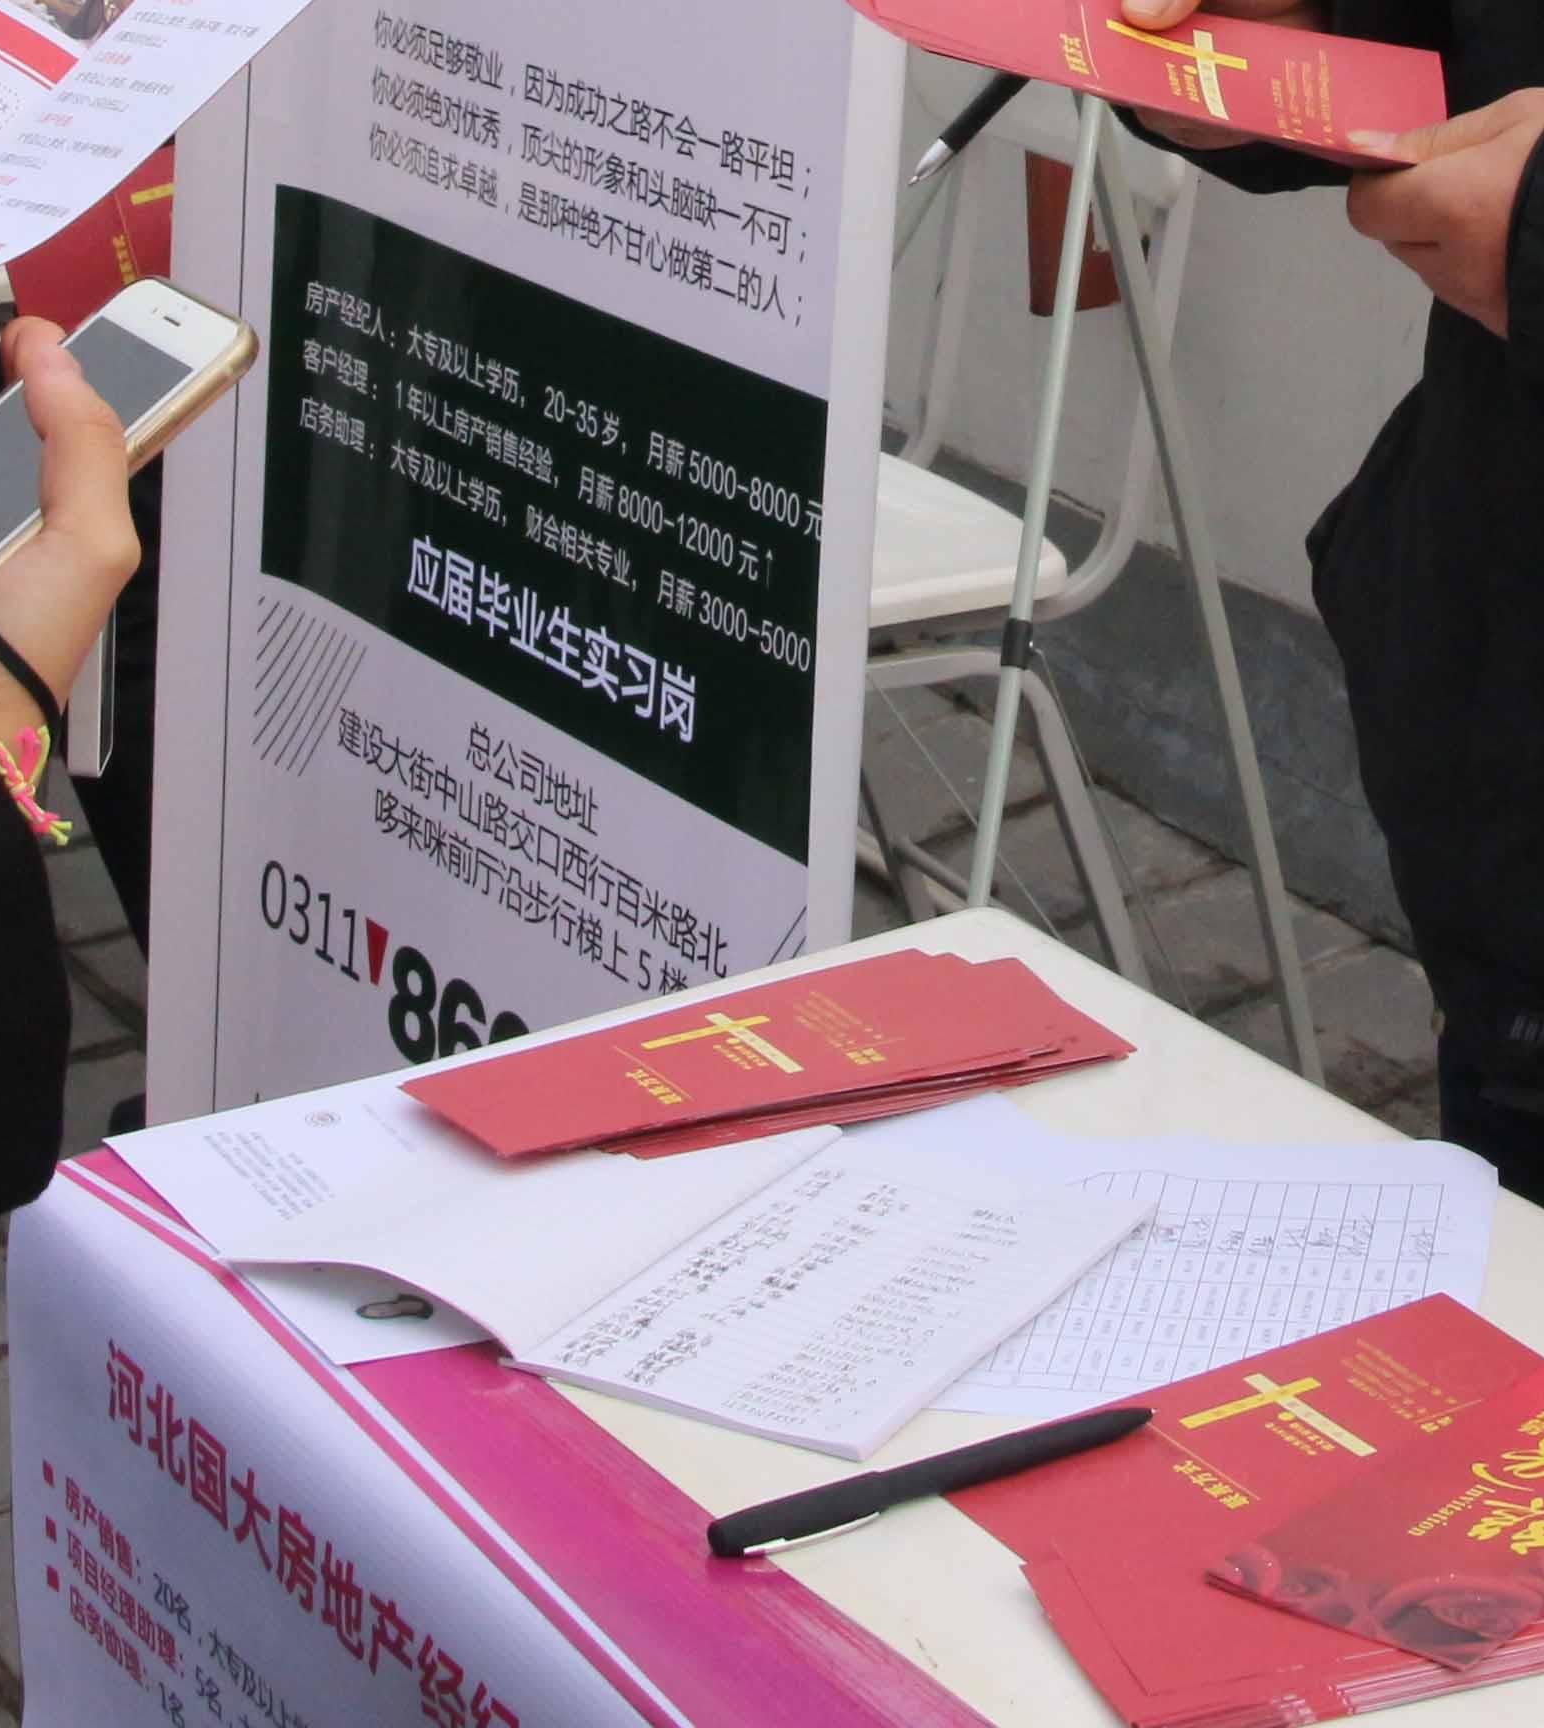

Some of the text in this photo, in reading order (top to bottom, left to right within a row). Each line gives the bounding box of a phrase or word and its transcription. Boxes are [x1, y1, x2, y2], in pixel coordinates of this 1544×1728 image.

[407, 536, 696, 743] 应届毕业生实习岗
[466, 722, 599, 836] 总公司地址
[337, 707, 728, 978] 建设大街中山路交口西行百米路北
[261, 860, 360, 982] 0311
[1173, 1460, 1250, 1510] 联系方式
[1408, 1485, 1495, 1536] Invitation
